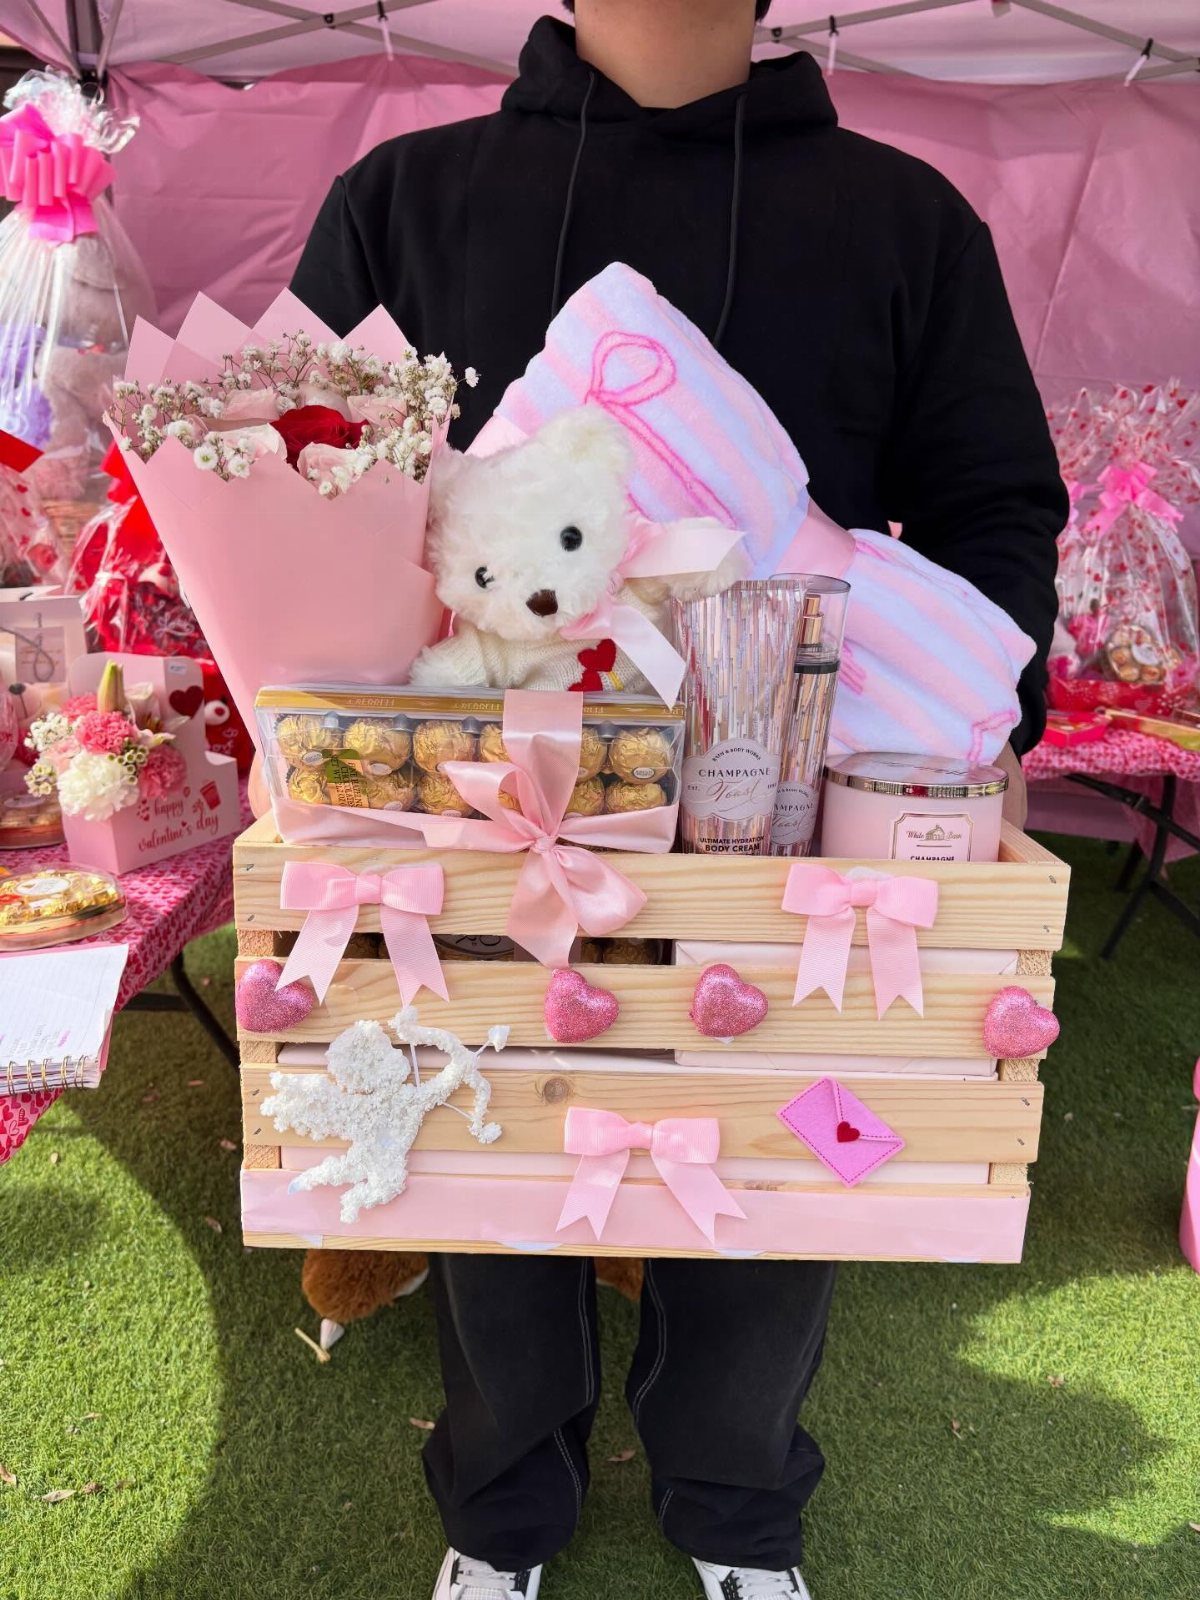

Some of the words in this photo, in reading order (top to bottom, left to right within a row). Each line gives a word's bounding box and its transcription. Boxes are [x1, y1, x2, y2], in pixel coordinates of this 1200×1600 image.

[698, 767, 771, 778] CHAMPAGNE
[154, 800, 184, 820] happy
[196, 803, 219, 835] day
[700, 837, 731, 845] ULTIMATE
[731, 835, 765, 844] HYDRATION
[705, 844, 730, 852] BODY
[732, 843, 760, 852] CREAM
